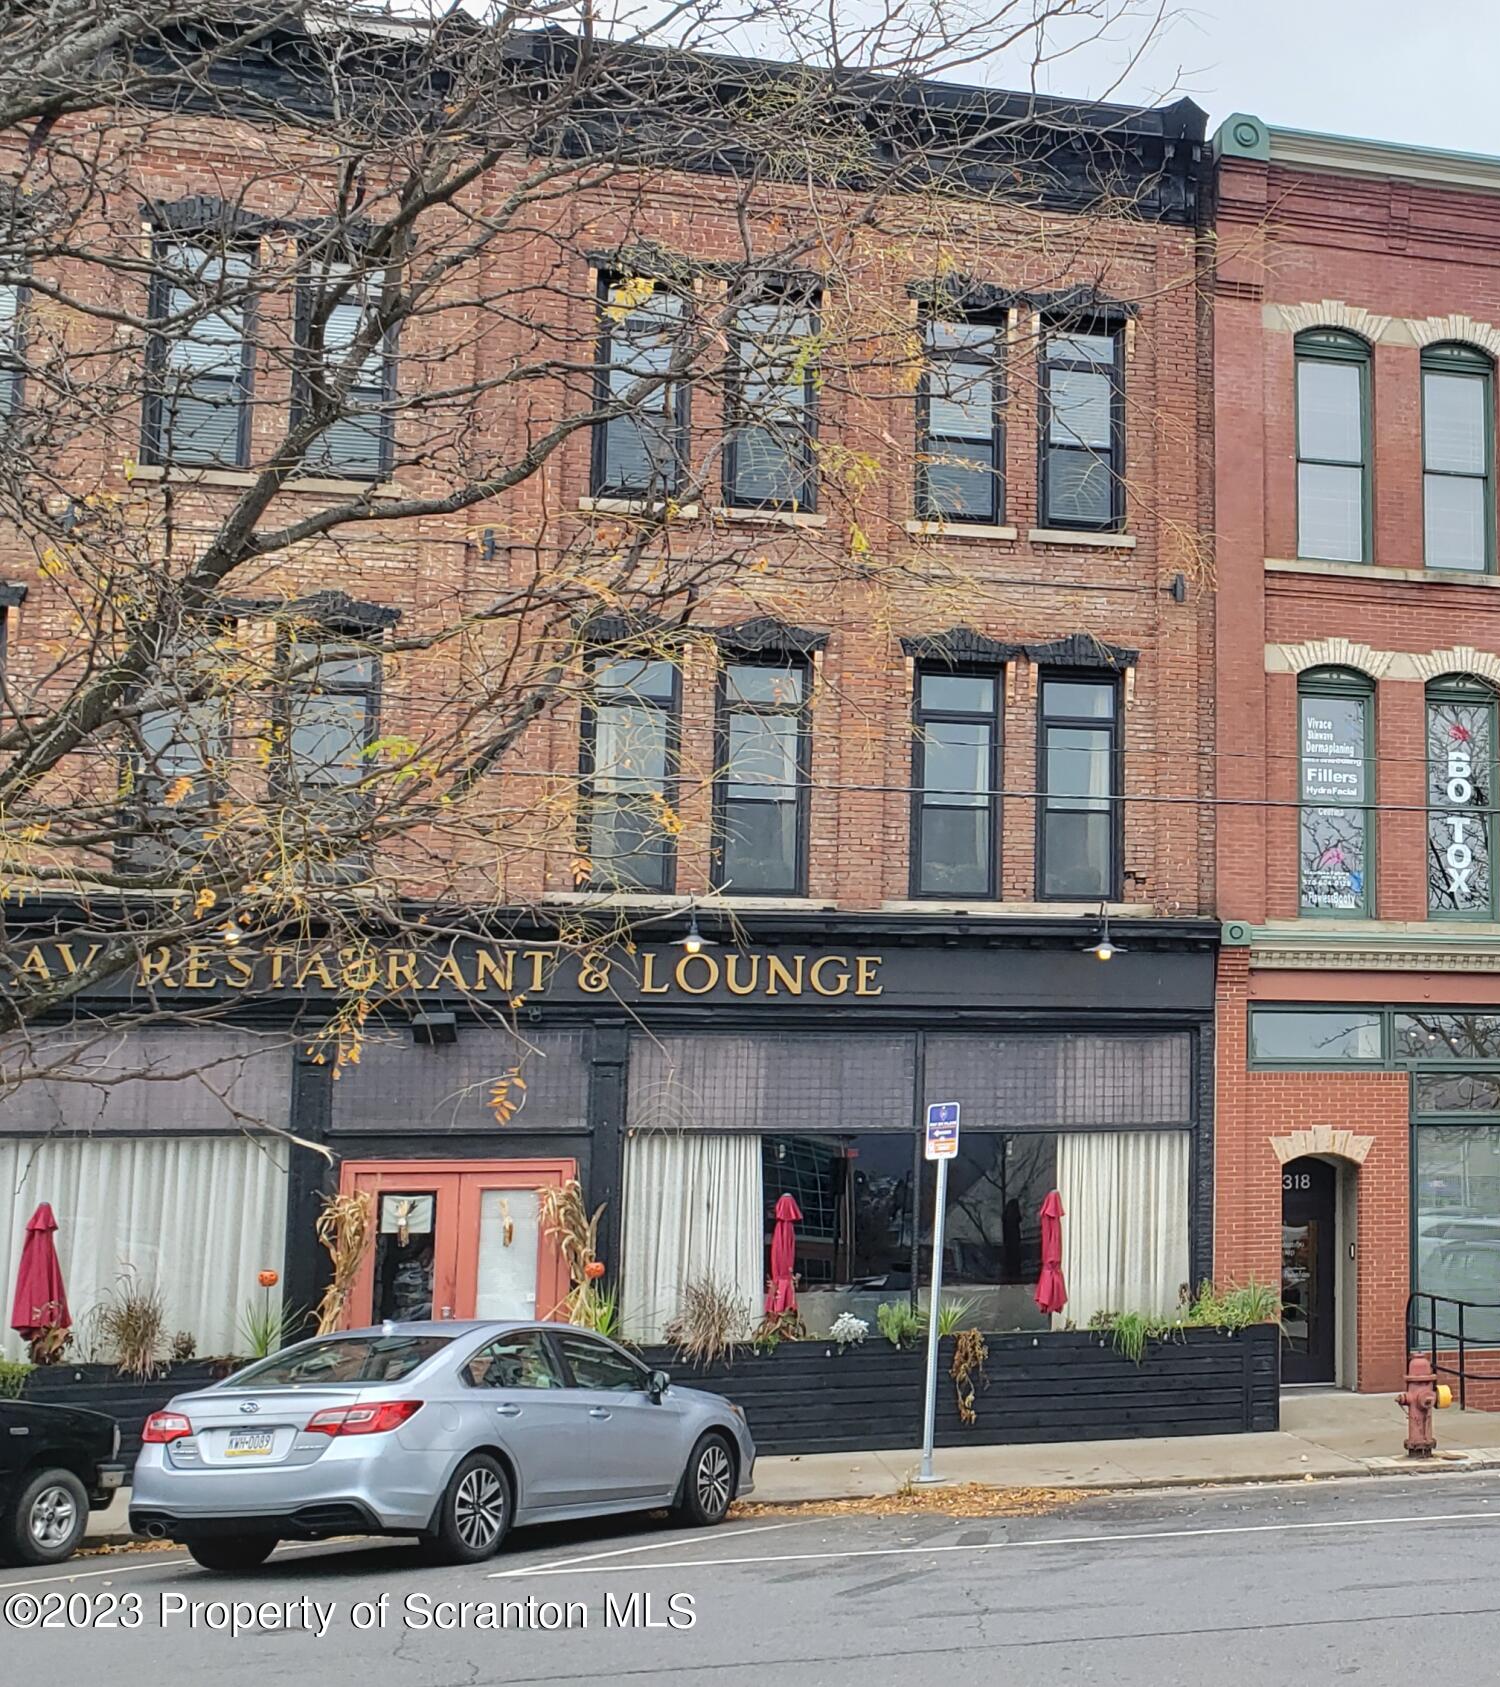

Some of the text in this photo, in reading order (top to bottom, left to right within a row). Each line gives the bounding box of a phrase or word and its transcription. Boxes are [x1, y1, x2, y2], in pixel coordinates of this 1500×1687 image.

[1307, 717, 1332, 730] Vivace
[1306, 741, 1354, 757] Dermaplaning
[1307, 768, 1358, 784] Fillers
[137, 944, 555, 991] RESTAURANT
[577, 948, 611, 993] &
[640, 953, 884, 996] LOUNGE
[1282, 1174, 1311, 1190] 318
